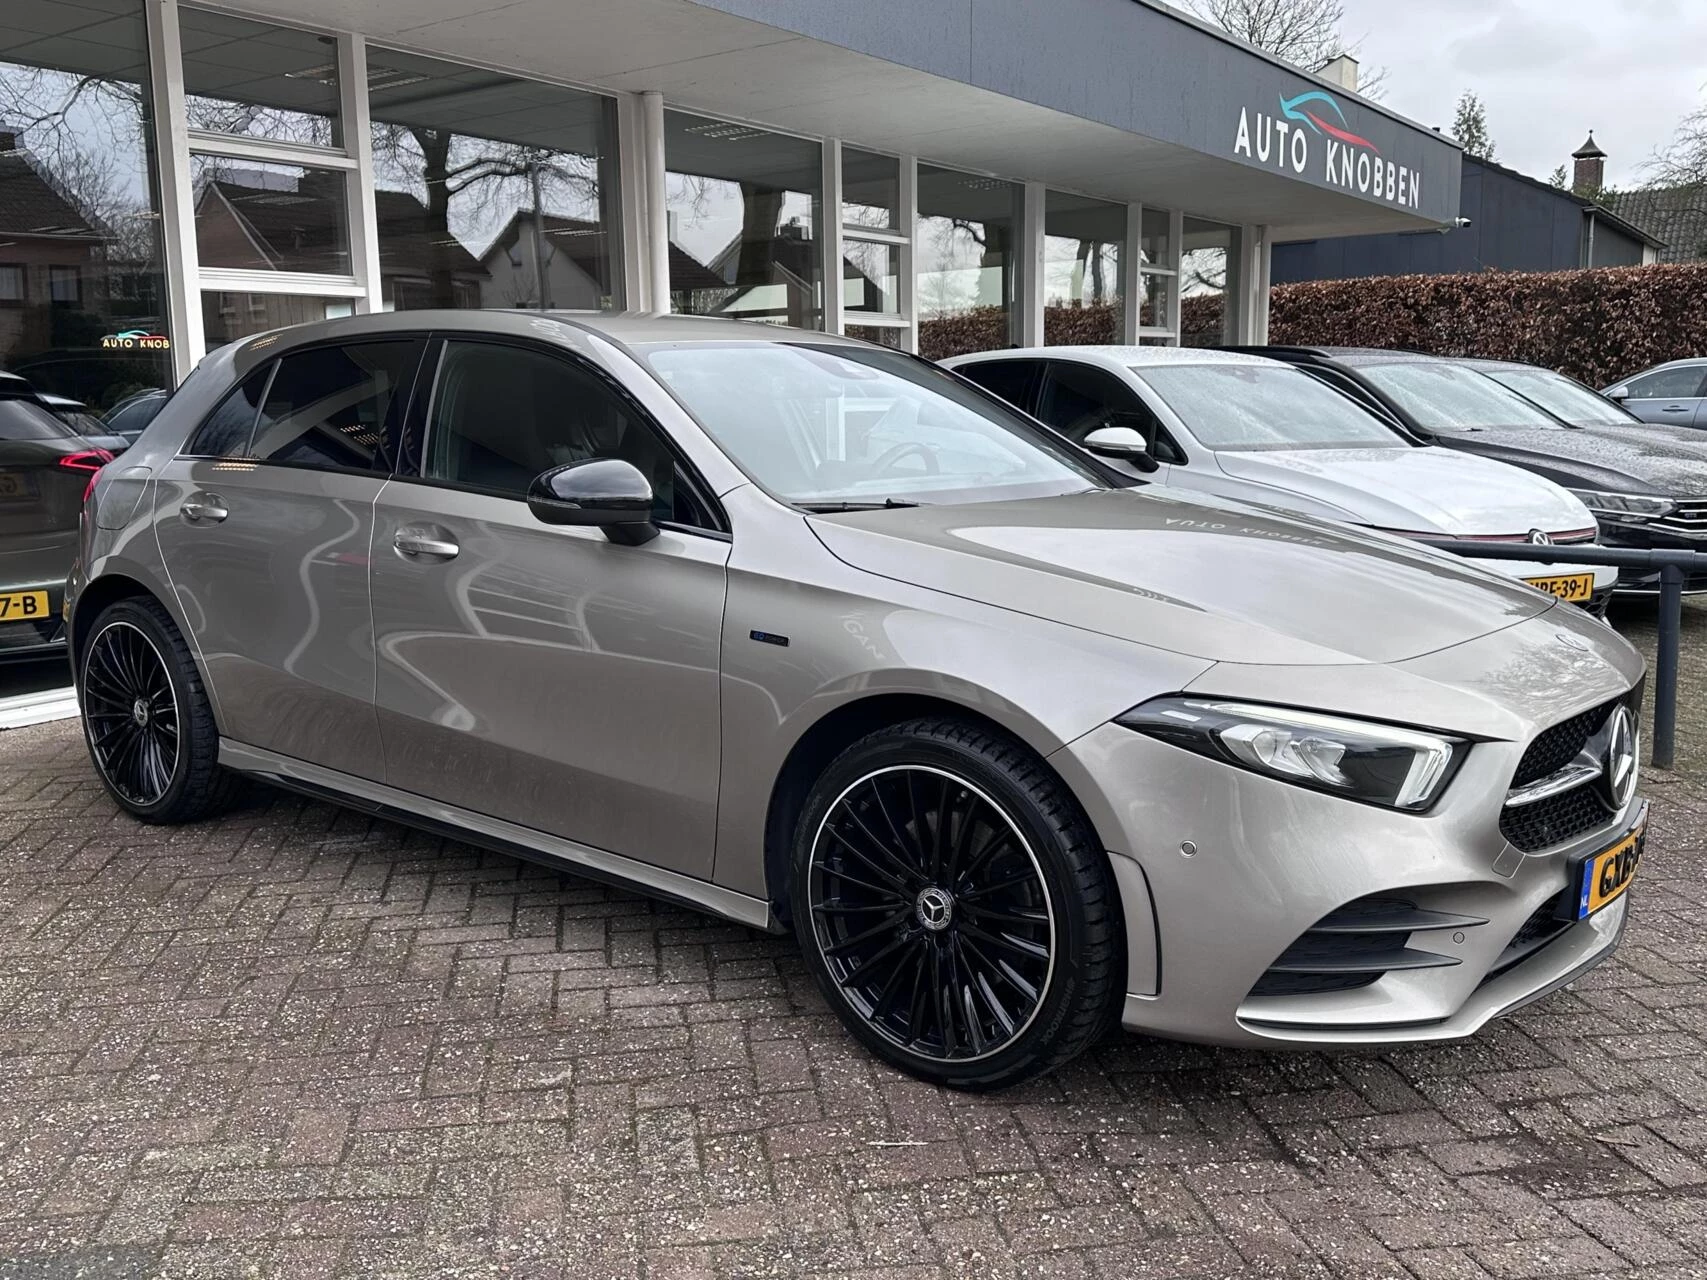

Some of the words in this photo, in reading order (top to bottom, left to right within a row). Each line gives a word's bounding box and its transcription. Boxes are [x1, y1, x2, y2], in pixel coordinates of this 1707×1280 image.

[1234, 106, 1307, 173] AUTO
[1326, 139, 1420, 209] KNOBBEN
[103, 338, 133, 348] AUTO
[140, 339, 170, 349] KNOB
[0, 596, 37, 617] 7-B
[1580, 895, 1588, 909] NL
